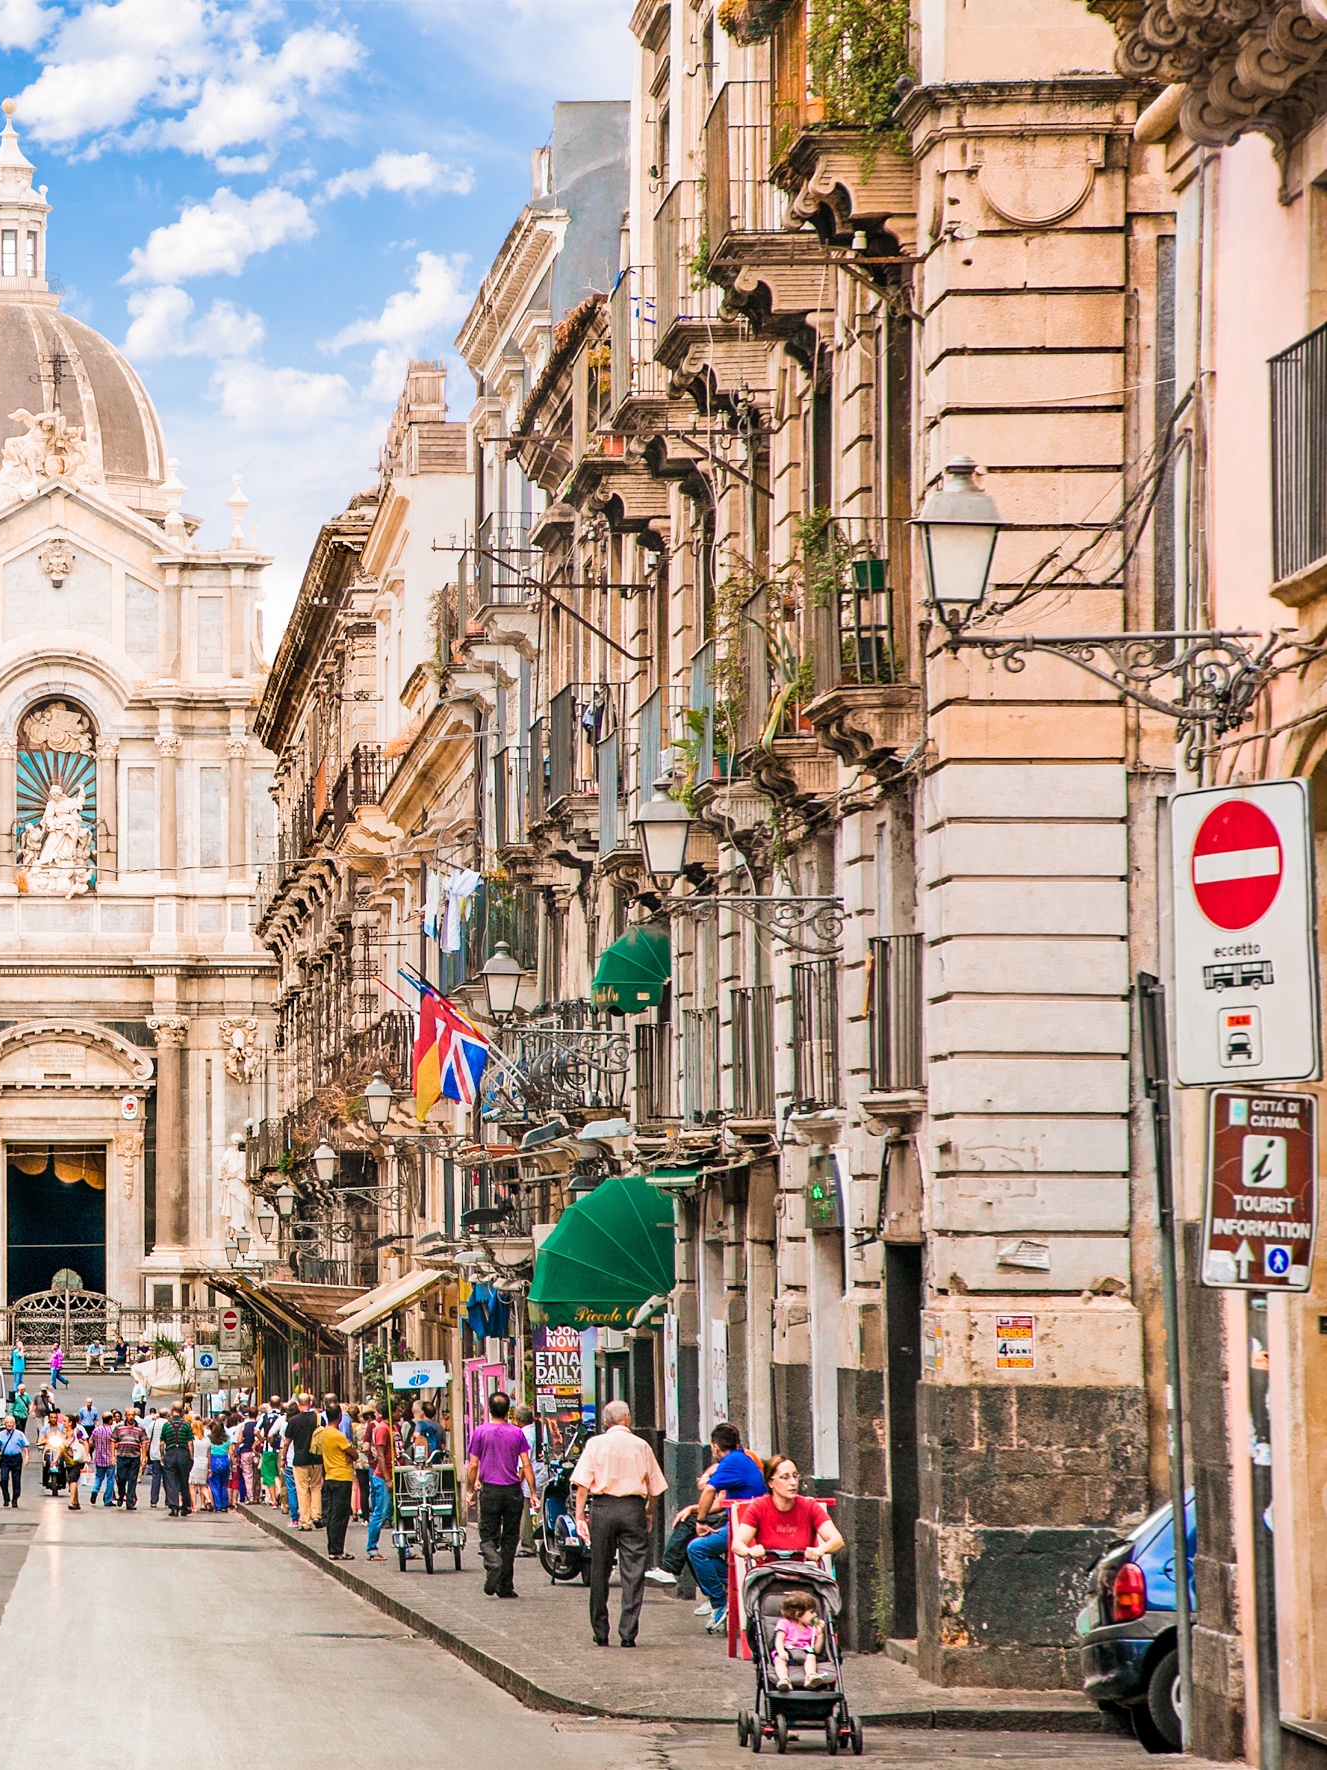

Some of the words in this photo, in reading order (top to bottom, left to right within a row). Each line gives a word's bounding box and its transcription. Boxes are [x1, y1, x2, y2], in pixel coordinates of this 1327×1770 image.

[1214, 943, 1261, 957] eccetto
[1229, 1016, 1249, 1025] TAXI
[1288, 1102, 1301, 1114] DI
[1250, 1115, 1300, 1129] CATANIA
[1233, 1194, 1295, 1214] TOURIST
[1212, 1217, 1311, 1239] INFORMATION
[574, 1306, 622, 1322] Piccolo
[997, 1328, 1032, 1338] VENDESI
[999, 1342, 1008, 1356] 4
[535, 1352, 581, 1365] ETNA
[535, 1366, 581, 1379] DAILY
